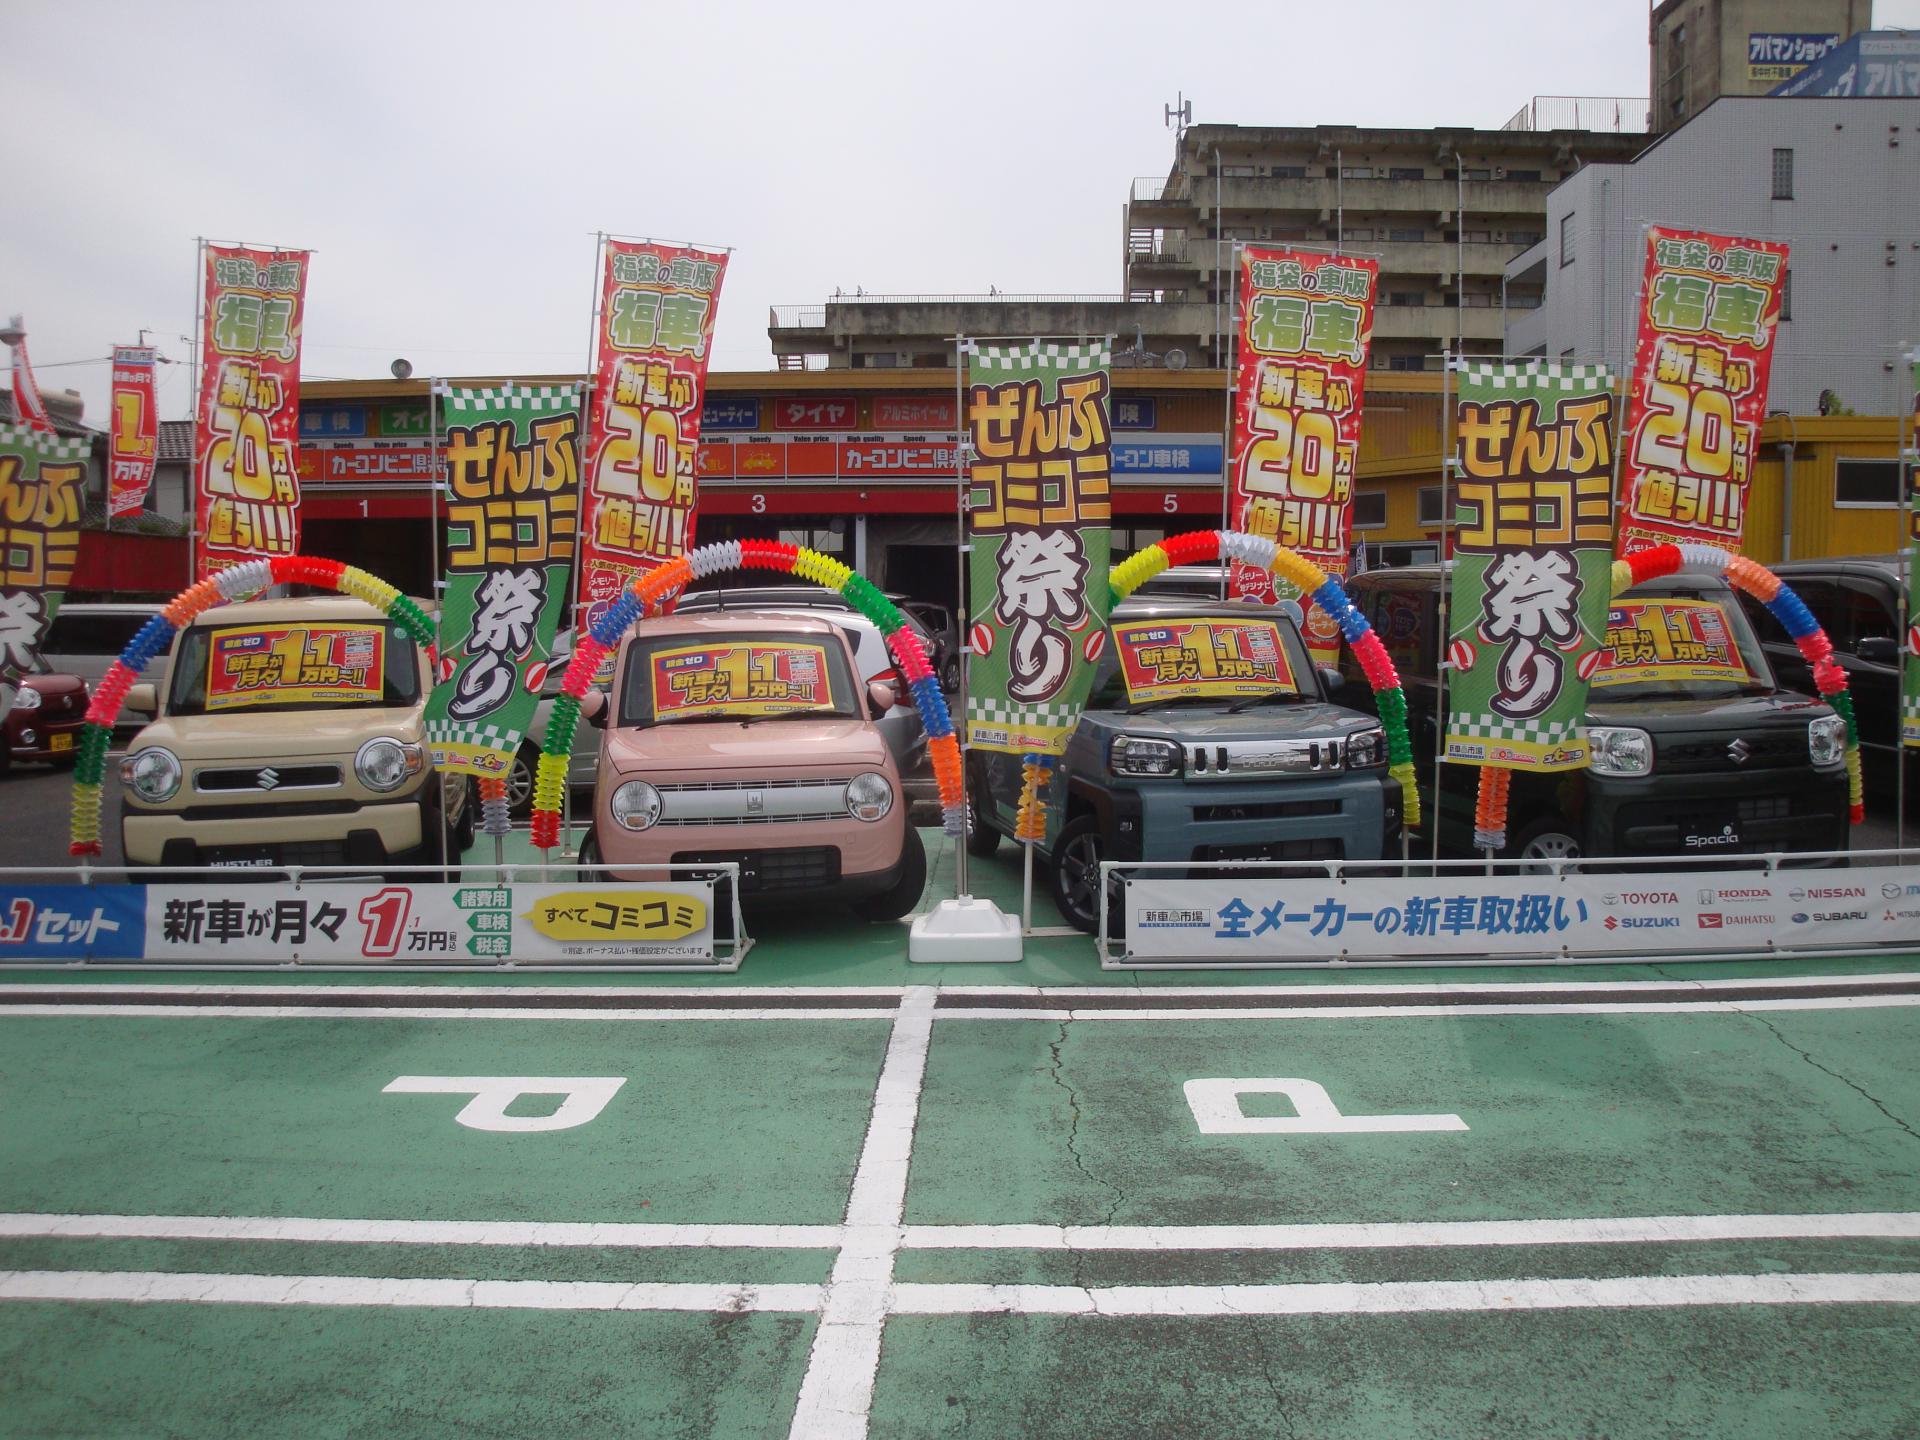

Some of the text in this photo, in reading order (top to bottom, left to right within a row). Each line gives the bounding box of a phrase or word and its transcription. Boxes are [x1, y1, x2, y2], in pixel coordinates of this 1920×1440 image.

[1750, 35, 1838, 61] アパマンショップ
[1656, 240, 1778, 281] 福袋の車版
[614, 255, 719, 289] 福袋の車版
[1253, 262, 1369, 298] 福袋の車版
[1654, 275, 1767, 338] 福車
[613, 291, 709, 349] 福車
[1253, 297, 1361, 354] 福車
[1657, 341, 1748, 393] 新車が
[616, 362, 691, 408] 新車が
[1260, 366, 1349, 411] 新車が
[787, 404, 846, 424] タイヤ
[882, 404, 948, 421] アルミホイール
[970, 378, 1106, 458] ぜんぶ
[749, 435, 772, 444] Speedy
[794, 435, 829, 444] Value price
[846, 436, 884, 445] High quality
[903, 435, 926, 444] Speedy
[1458, 400, 1608, 478] ぜんぶ
[332, 454, 446, 474] カーコンビニ倶楽
[448, 418, 578, 499] ぜんぶ
[847, 449, 970, 469] カーコンビニ倶楽
[1111, 449, 1190, 468] ーコン車検
[971, 454, 1112, 528] コミコミ
[1637, 470, 1740, 530] 値引!!
[359, 499, 368, 518] 1
[752, 494, 766, 513] 3
[1163, 494, 1178, 513] 5
[1458, 476, 1612, 547] コミコミ
[448, 494, 578, 567] コミコミ
[599, 497, 685, 557] 値引!!
[0, 530, 80, 586] コミ
[1001, 529, 1082, 697] 祭り
[451, 567, 542, 714] 祭り
[1489, 550, 1576, 712] 祭り
[228, 653, 283, 672] 新車が
[1139, 648, 1197, 666] 新車が
[1616, 645, 1655, 662] 月々
[238, 669, 281, 686] 月々
[672, 671, 730, 690] 新車が
[1157, 662, 1199, 680] 月々
[687, 685, 729, 702] 月々
[1685, 831, 1739, 847] Spacia
[460, 890, 507, 908] 諸費用
[1620, 892, 1679, 905] TOYOTA
[1718, 888, 1772, 898] HONDA
[1807, 887, 1866, 899] NISSAN
[164, 899, 348, 945] 新車が月々
[475, 912, 507, 931] 車検
[1215, 894, 1588, 938] 全メーカーの新車取扱い
[1621, 917, 1680, 928] SUZUKI
[1726, 914, 1775, 926] DAIHATSU
[1812, 911, 1868, 922] SUBARU
[475, 937, 508, 954] 税金
[381, 1076, 627, 1133] P
[1183, 1078, 1471, 1134] P
